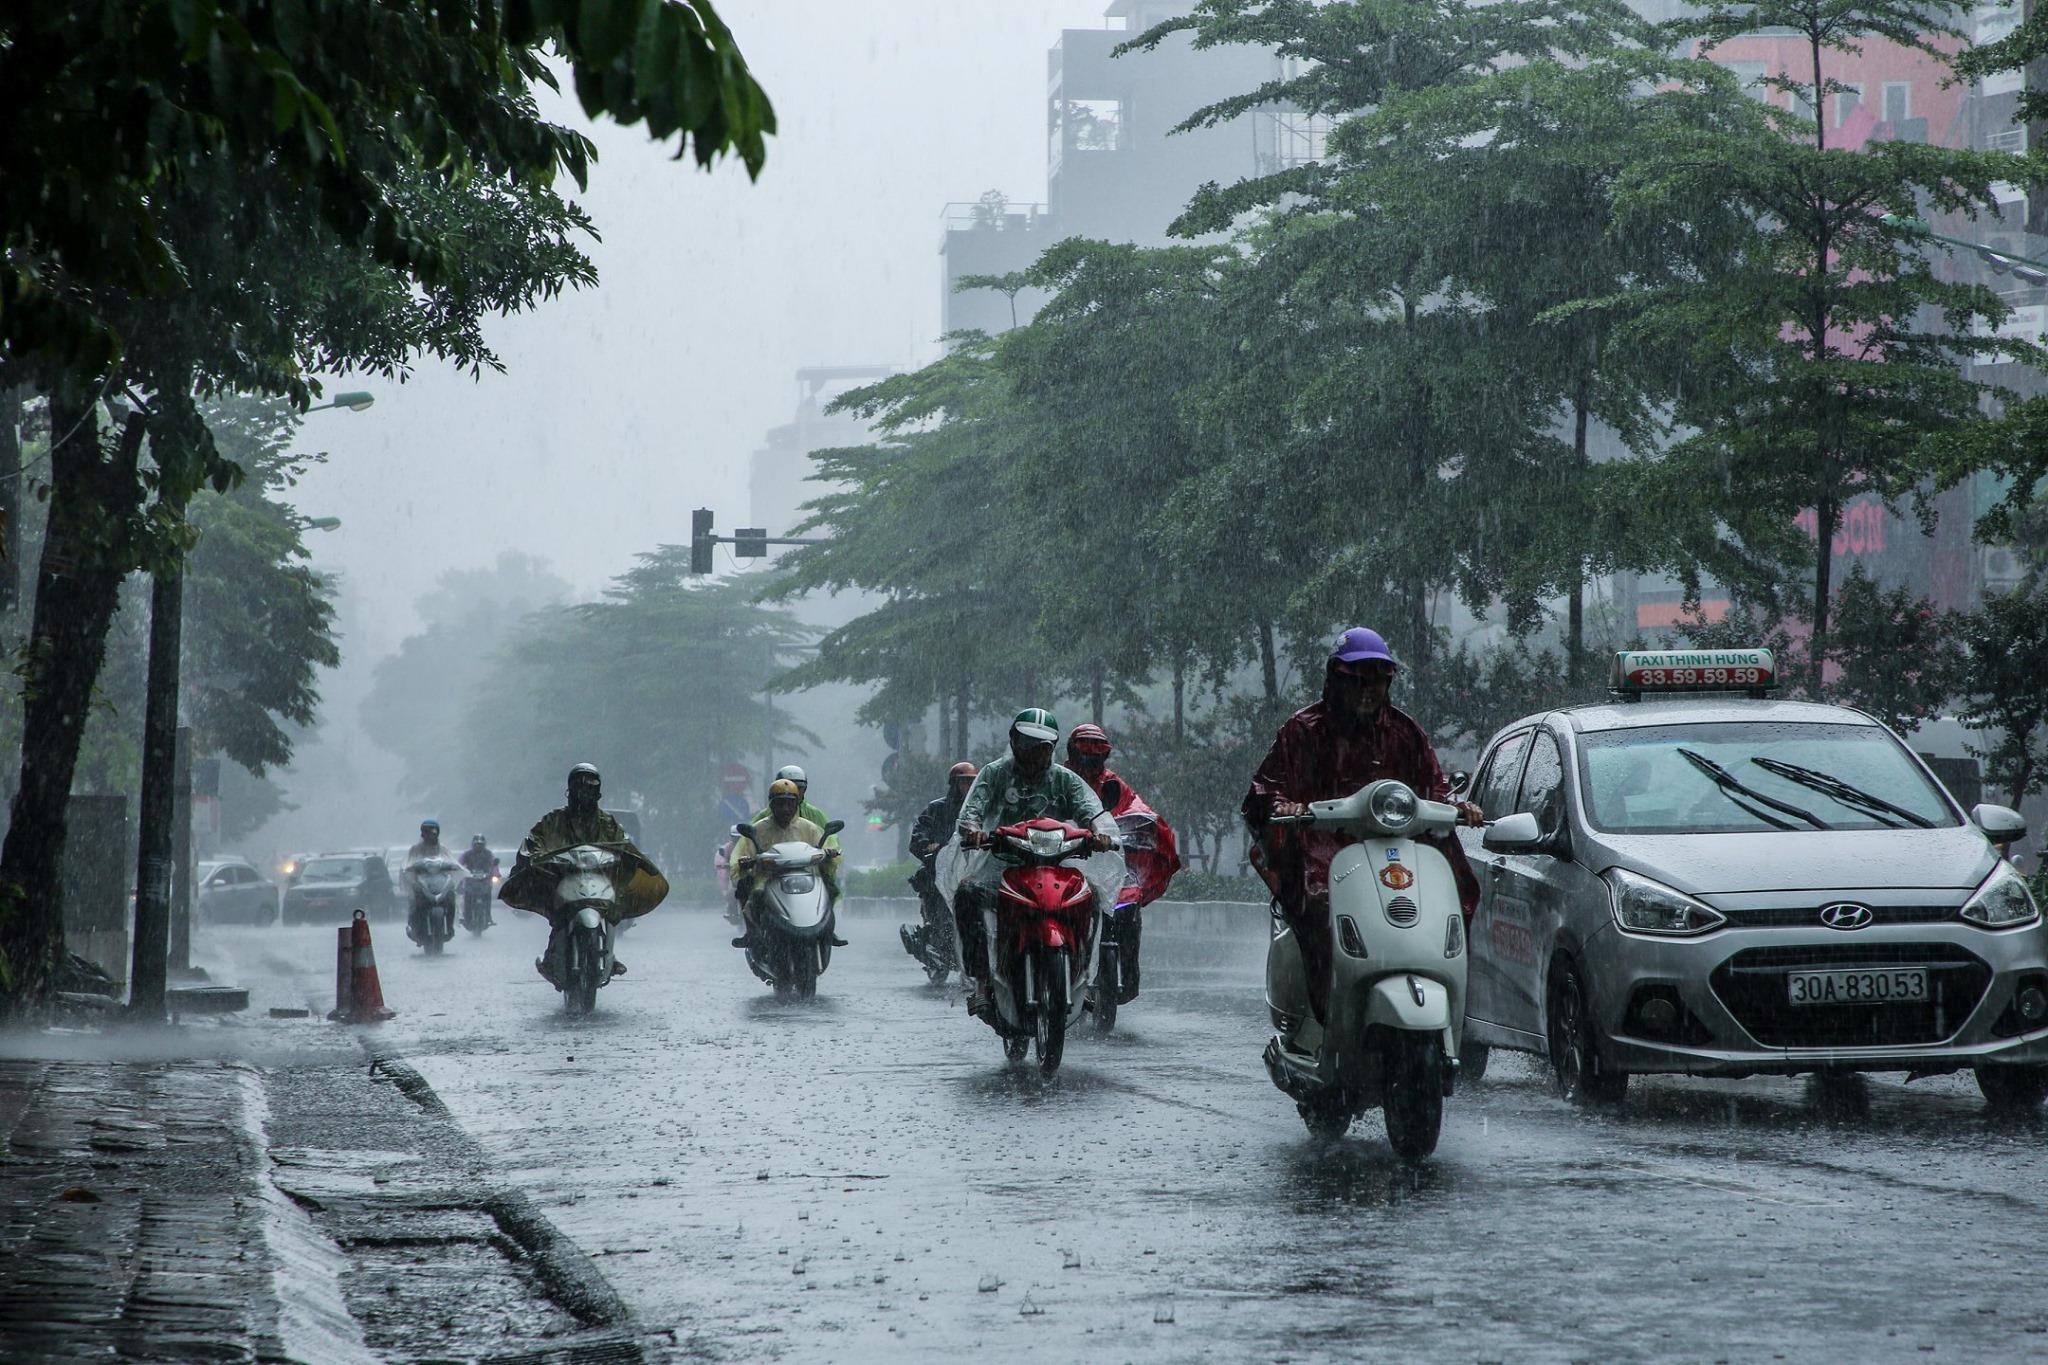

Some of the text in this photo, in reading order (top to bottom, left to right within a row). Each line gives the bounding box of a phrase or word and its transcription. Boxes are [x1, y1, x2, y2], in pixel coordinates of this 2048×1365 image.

[1632, 655, 1664, 667] TAXI
[1716, 652, 1759, 665] HƯNG
[1641, 668, 1760, 685] 33.59.59.59
[1792, 972, 1924, 1001] 30A-830.53
